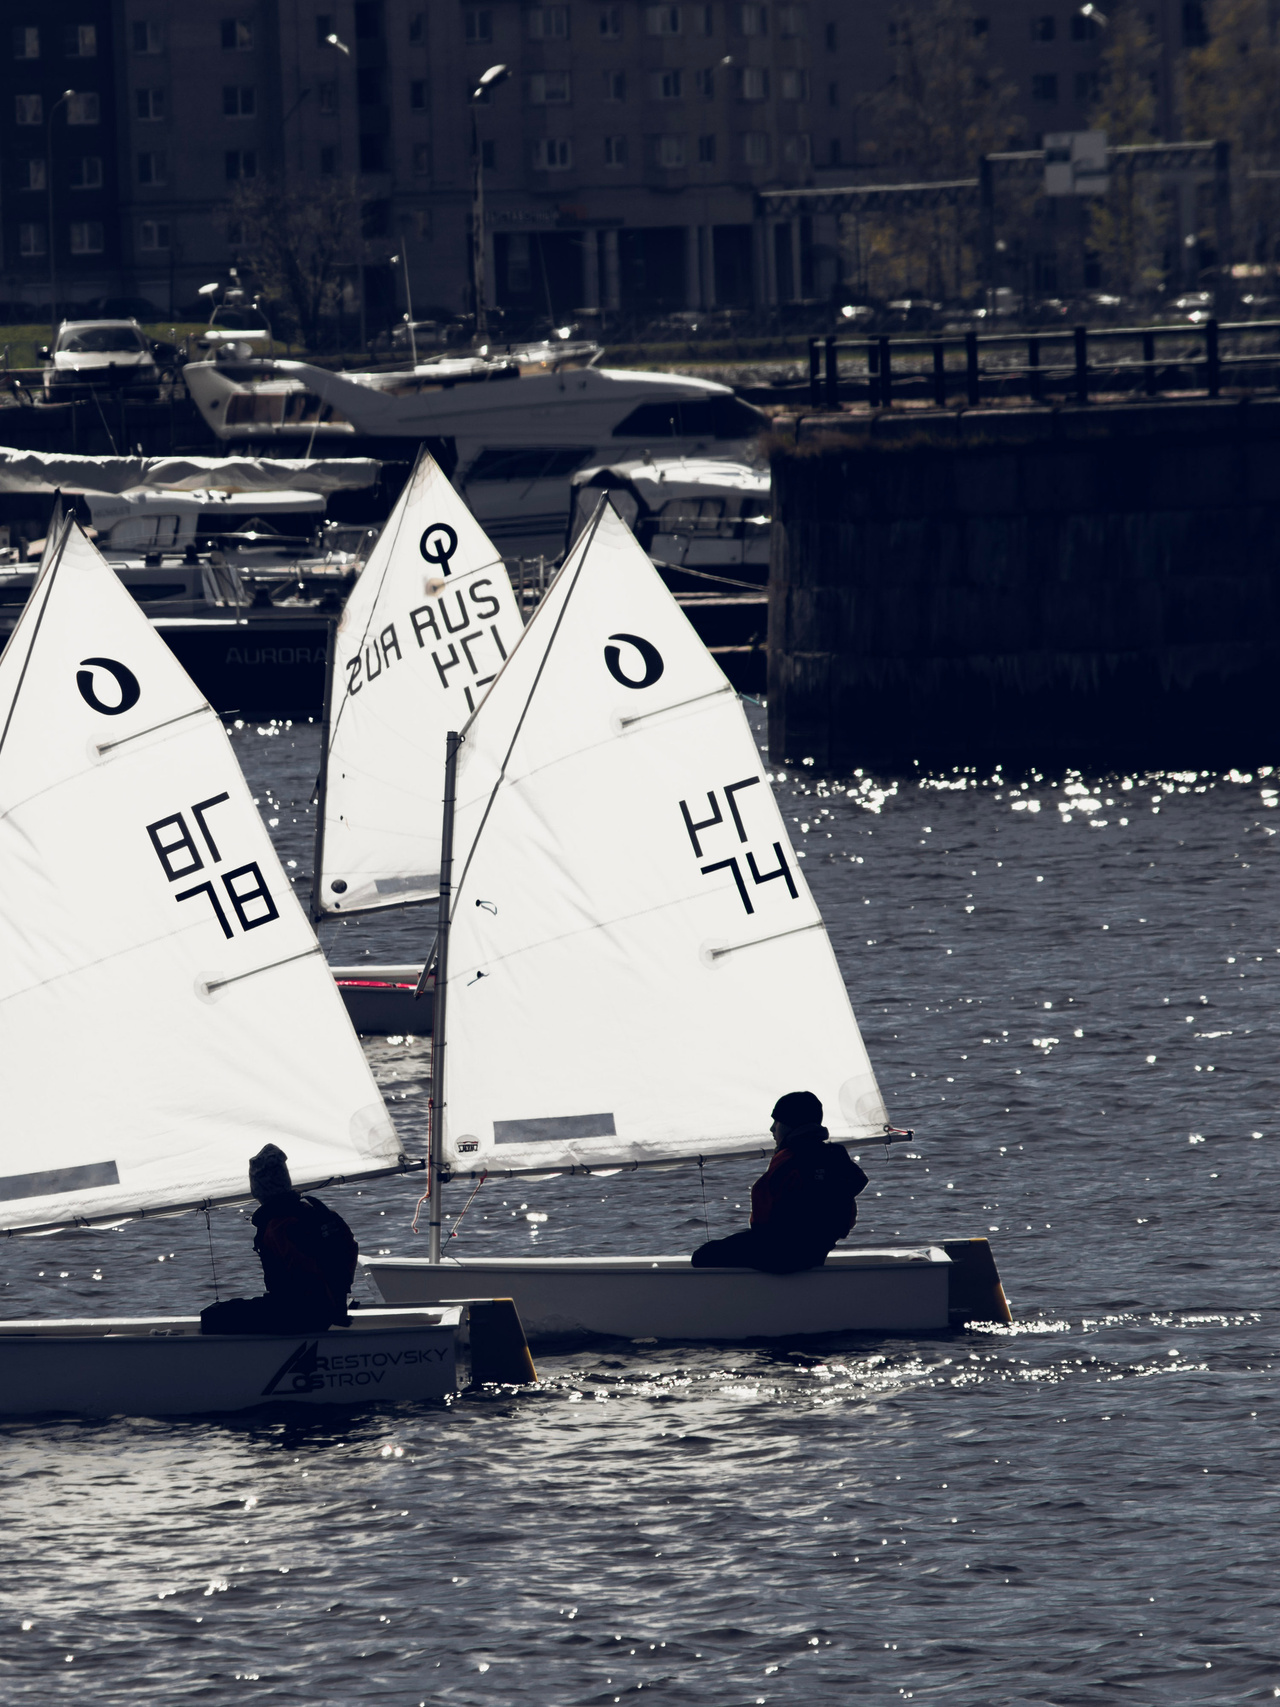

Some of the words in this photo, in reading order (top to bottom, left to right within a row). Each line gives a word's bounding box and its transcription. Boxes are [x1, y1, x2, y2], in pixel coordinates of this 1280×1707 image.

[410, 579, 501, 649] RUS
[175, 861, 280, 940] 78
[701, 842, 800, 915] 74
